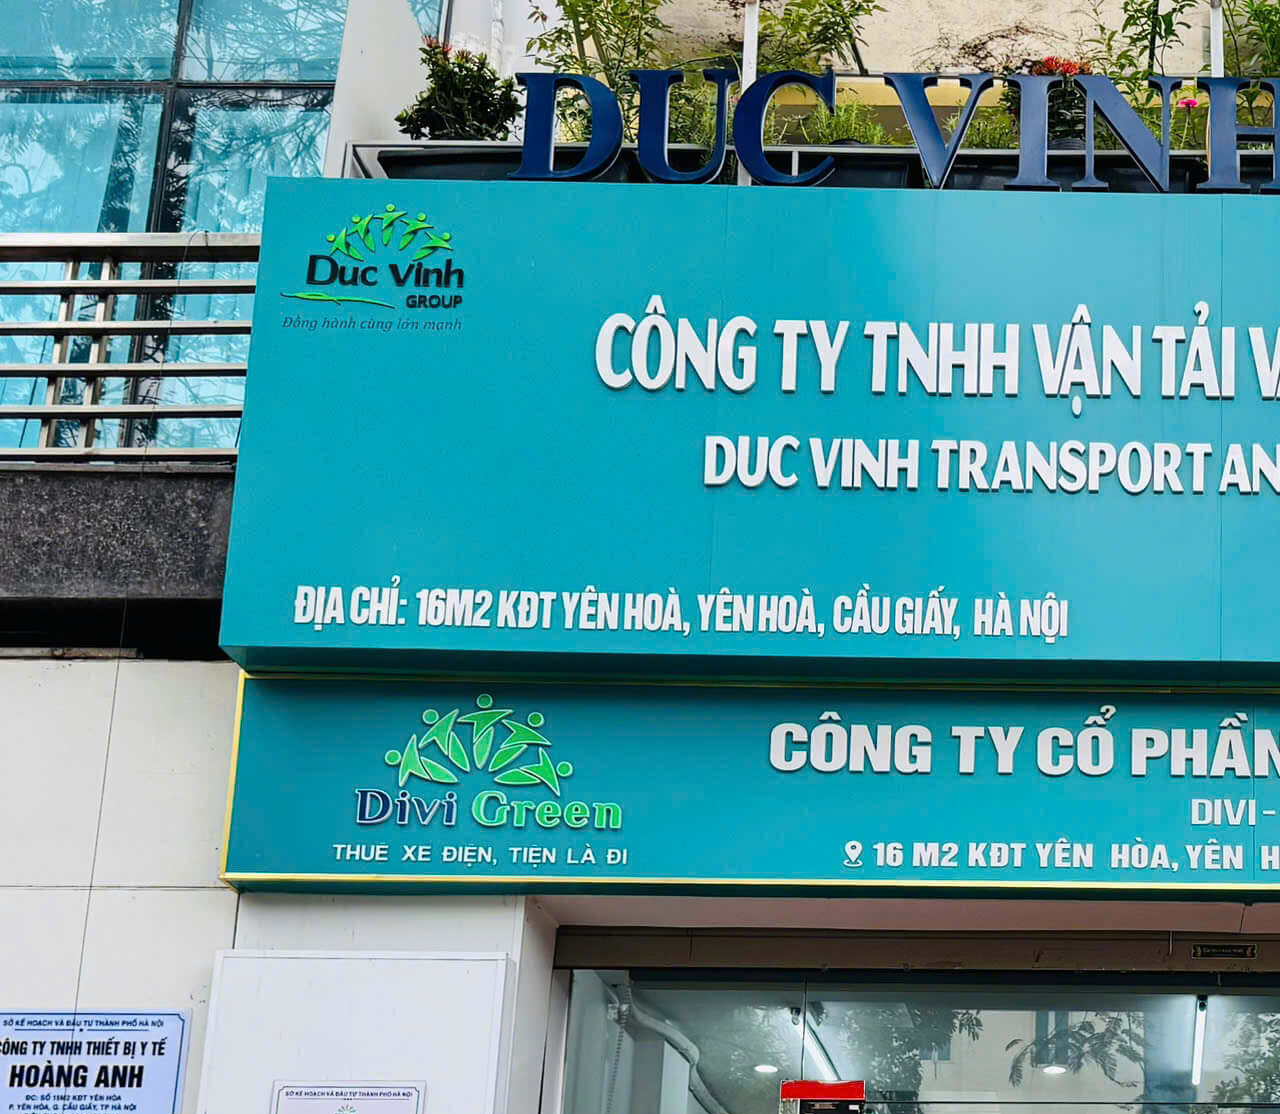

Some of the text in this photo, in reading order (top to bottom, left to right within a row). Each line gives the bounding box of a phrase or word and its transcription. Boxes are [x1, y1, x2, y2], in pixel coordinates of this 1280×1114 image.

[508, 68, 837, 187] DUC
[306, 254, 379, 287] Duc
[406, 295, 462, 309] GROUP
[321, 317, 357, 330] hành
[359, 316, 393, 332] cùng
[423, 318, 462, 332] mạnh
[594, 294, 759, 393] CÔNG
[773, 319, 850, 393] TY
[864, 321, 1021, 398] TNHH
[1033, 303, 1143, 417] VẬN
[1152, 300, 1236, 400] TẢI
[704, 435, 801, 489] DUC
[809, 437, 920, 491] VINH
[930, 439, 1213, 494] TRANSPORT
[294, 575, 1069, 645] ĐỊA CHỈ: 16M2 KĐT YÊN HOÀ, YÊN HOÀ, CẦU GIẤY, HÀ NỘI
[769, 711, 932, 775] CÔNG
[951, 726, 1025, 776] TY
[1037, 705, 1117, 777] CỔ
[355, 788, 624, 830] Divi Green
[1190, 798, 1256, 827] DIVI
[332, 841, 629, 869] THUÊ XE ĐIỆN, TIỆN LÀ ĐI
[872, 842, 904, 868] 16
[912, 842, 958, 869] M2
[968, 842, 1027, 869] KĐT
[1036, 838, 1094, 869] YÊN
[1111, 837, 1179, 873] HÒA,
[1185, 839, 1243, 870] YÊN
[0, 1036, 168, 1059] ÔNG TY TNHH THIẾT BỊ Y TẾ
[9, 1060, 145, 1088] HOÀNG ANH
